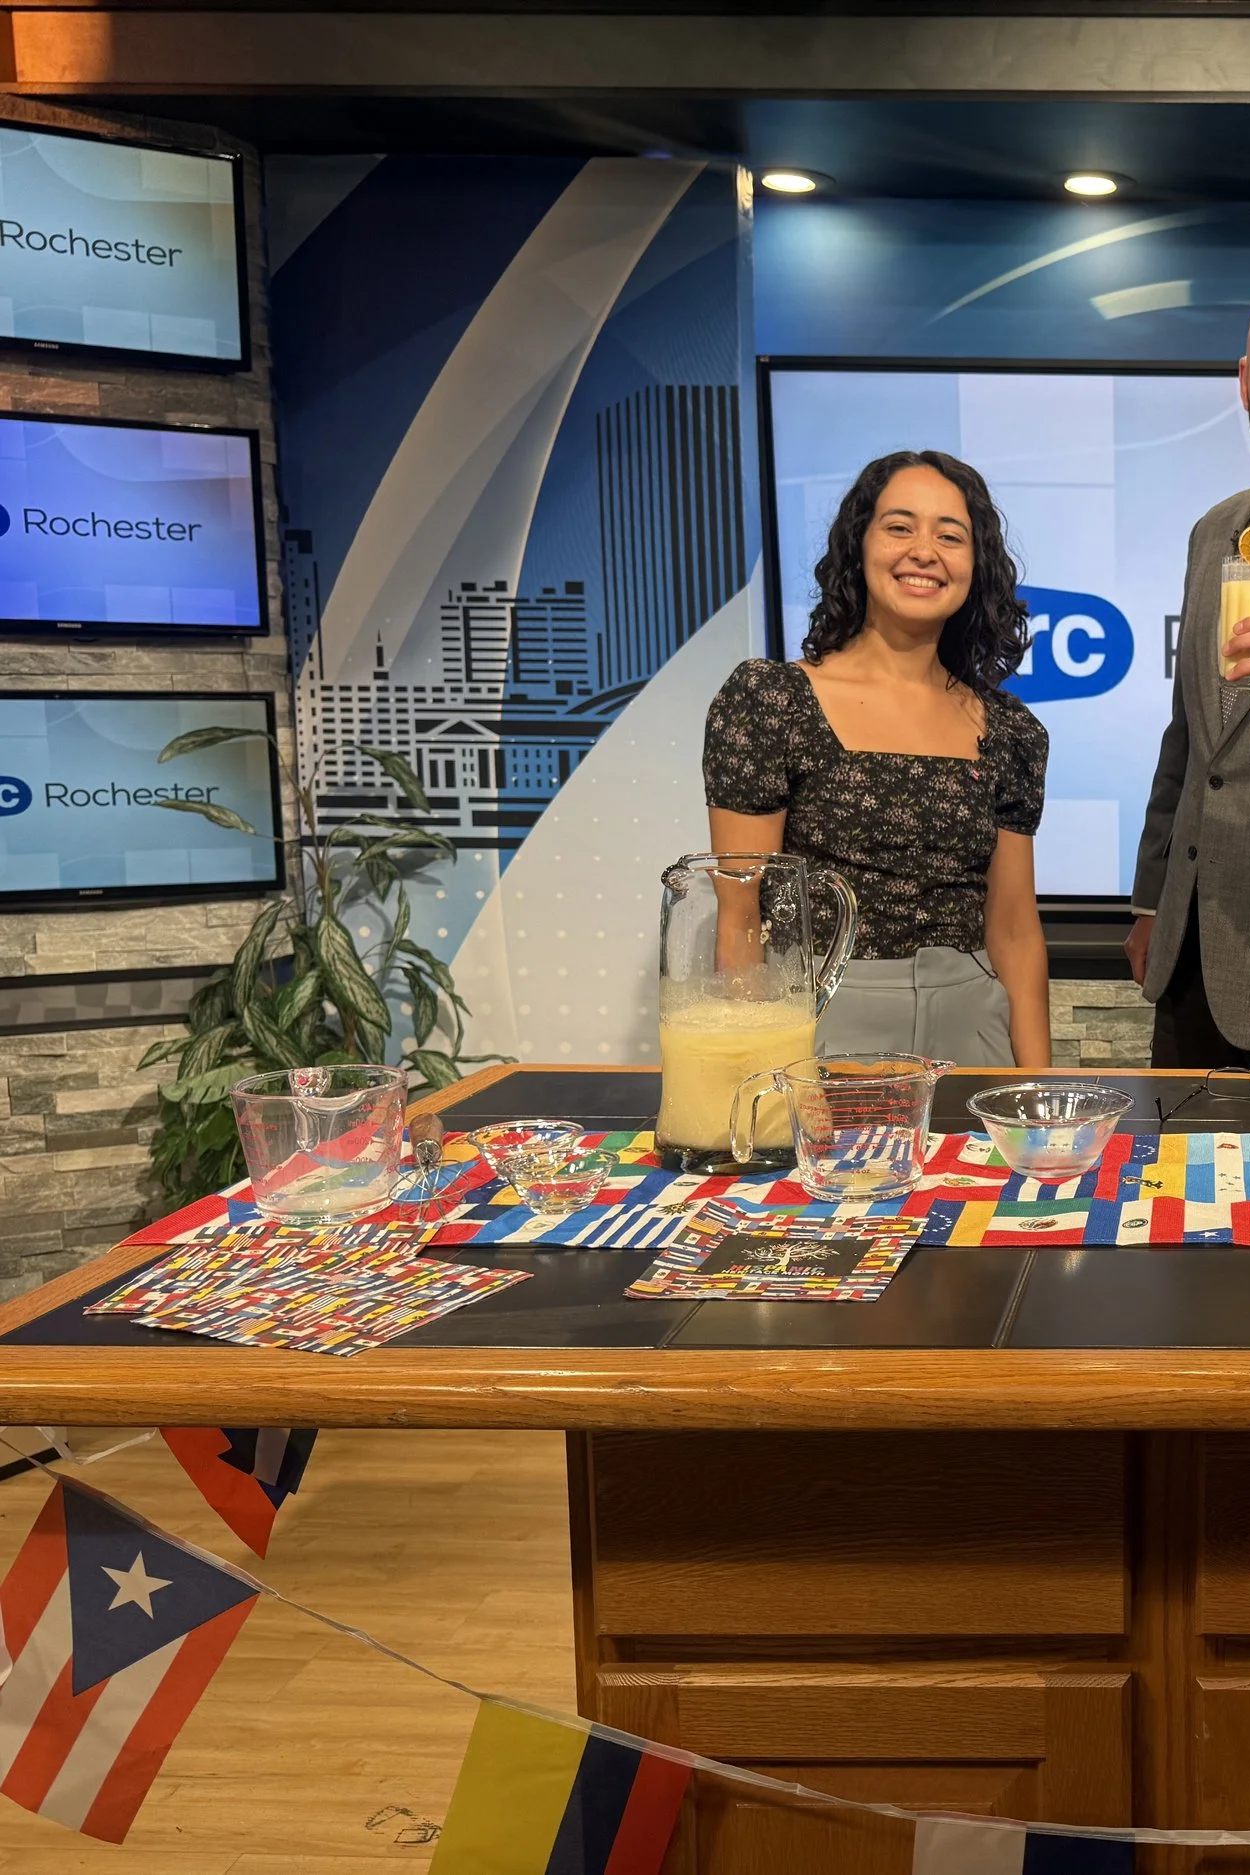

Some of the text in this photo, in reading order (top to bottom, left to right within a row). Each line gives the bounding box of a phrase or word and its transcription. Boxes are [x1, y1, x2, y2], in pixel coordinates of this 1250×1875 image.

[0, 219, 183, 267] Rochester
[23, 508, 202, 542] Rochester
[45, 782, 220, 807] Rochester
[729, 1264, 825, 1273] HISPANIC
